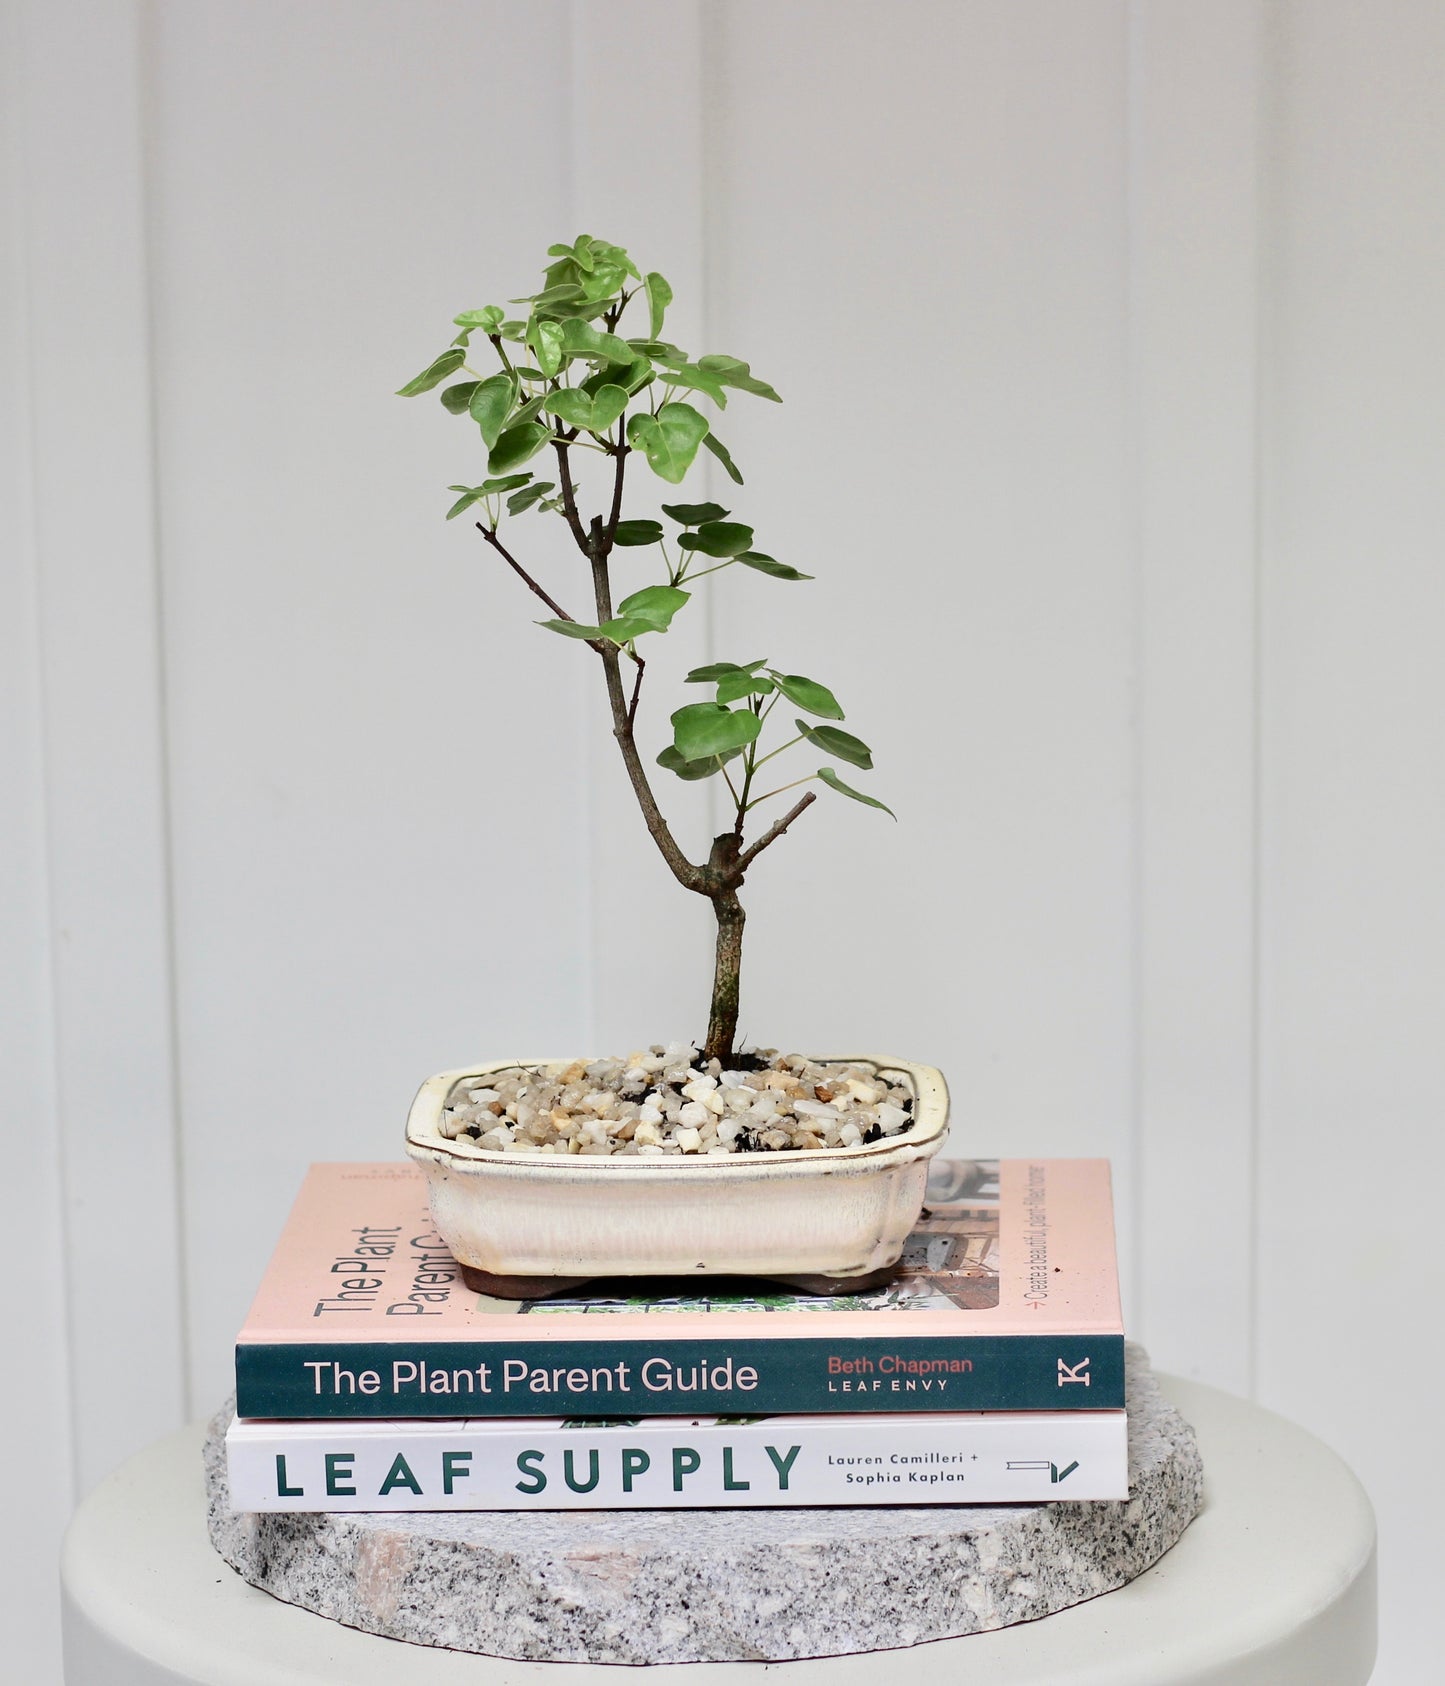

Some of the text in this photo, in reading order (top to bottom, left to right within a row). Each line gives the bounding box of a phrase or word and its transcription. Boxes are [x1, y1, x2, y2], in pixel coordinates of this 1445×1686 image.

[331, 1226, 402, 1273] Plant
[313, 1278, 382, 1317] The
[386, 1253, 457, 1316] Parent
[1023, 1272, 1048, 1300] Create
[304, 1357, 759, 1396] The Plant Parent Guide
[828, 1355, 973, 1376] Beth Chapman
[1057, 1356, 1091, 1387] K
[828, 1379, 948, 1392] LEAF ENVY
[275, 1445, 802, 1497] LEAF SUPPLY
[828, 1455, 882, 1466] Lauren
[890, 1453, 964, 1465] Camilleri
[846, 1471, 965, 1486] Sophia Kaplan
